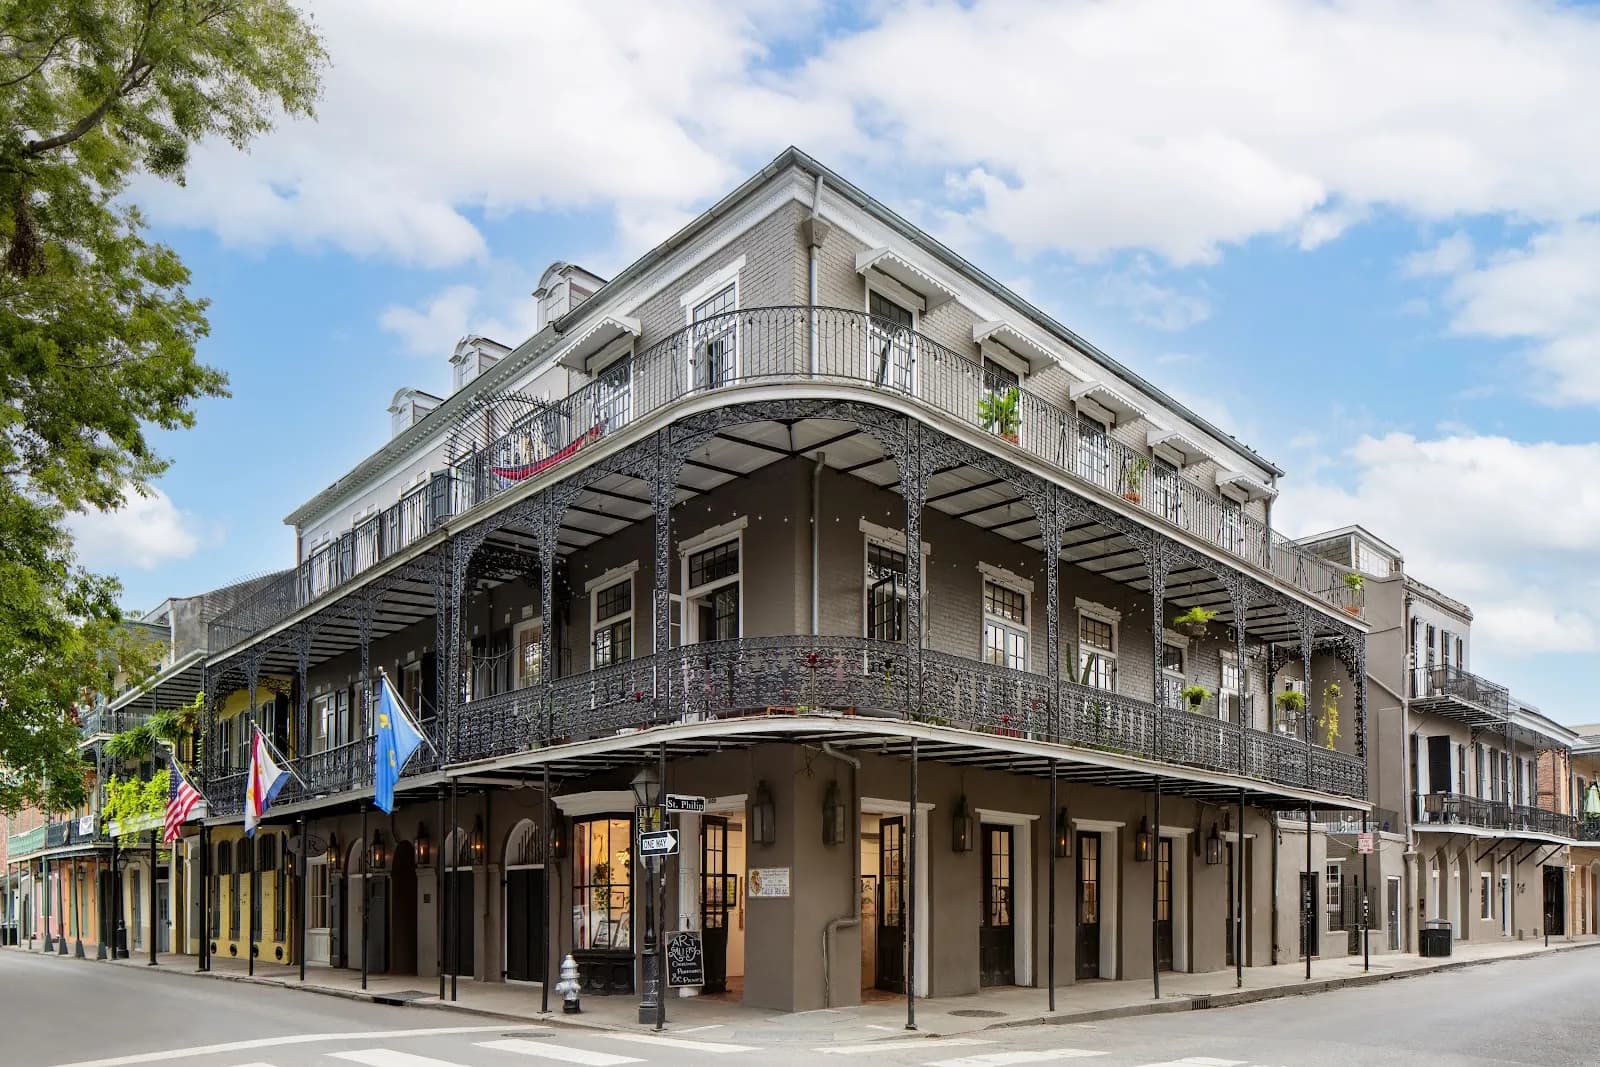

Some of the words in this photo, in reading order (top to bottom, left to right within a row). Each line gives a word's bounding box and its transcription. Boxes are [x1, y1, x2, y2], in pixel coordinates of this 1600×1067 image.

[667, 799, 679, 809] St.
[681, 800, 704, 811] Philip
[643, 839, 655, 849] ONE
[655, 838, 667, 848] WAY
[672, 934, 694, 947] ART
